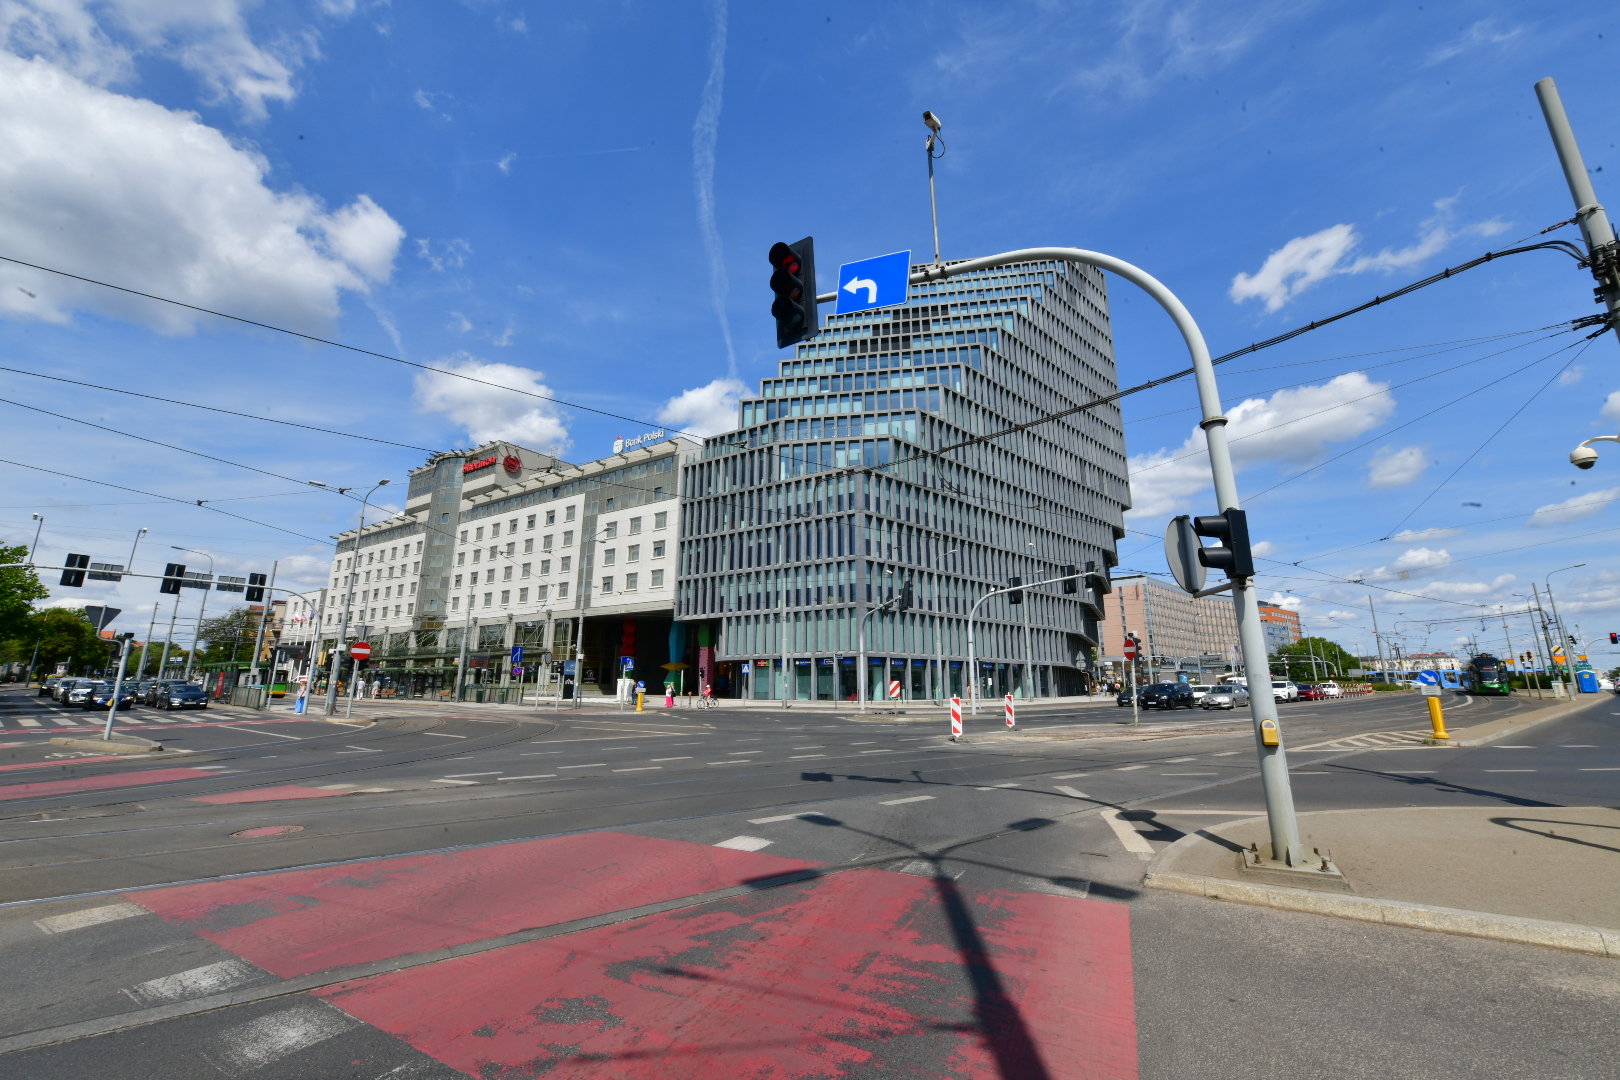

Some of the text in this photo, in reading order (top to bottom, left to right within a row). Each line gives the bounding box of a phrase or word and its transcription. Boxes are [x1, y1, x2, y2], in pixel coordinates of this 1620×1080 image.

[625, 428, 665, 447] Bank Polski
[462, 456, 497, 473] Sheraton
